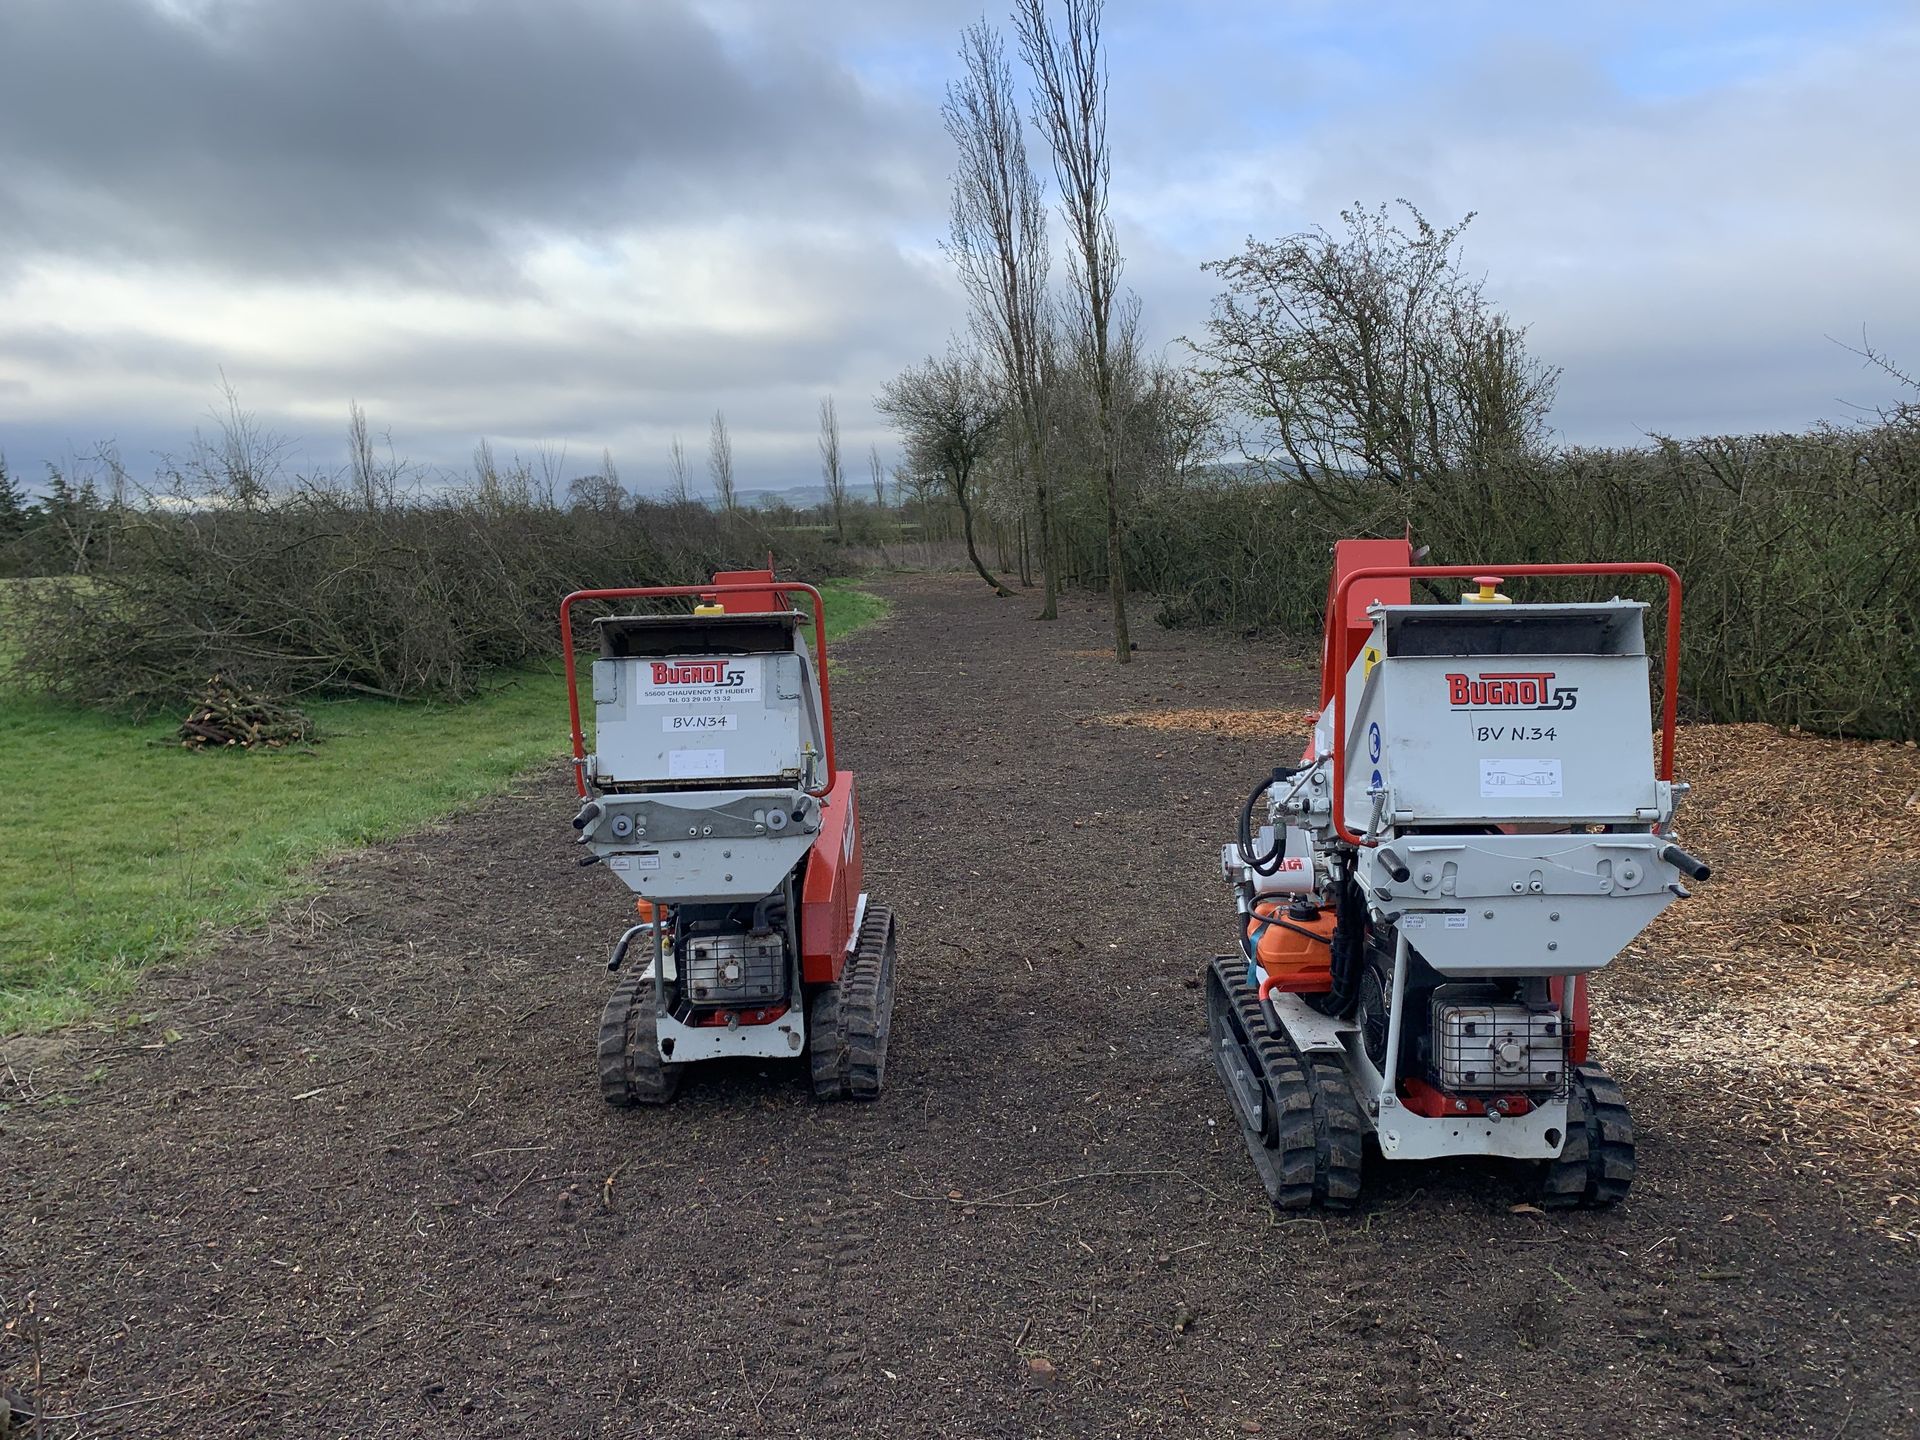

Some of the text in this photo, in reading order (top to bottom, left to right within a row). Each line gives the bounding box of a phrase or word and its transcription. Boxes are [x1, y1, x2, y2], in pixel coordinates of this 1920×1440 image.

[724, 670, 745, 687] 55
[1551, 687, 1579, 711] 55
[673, 716, 728, 729] BV.N34
[1477, 726, 1557, 742] BV N.34
